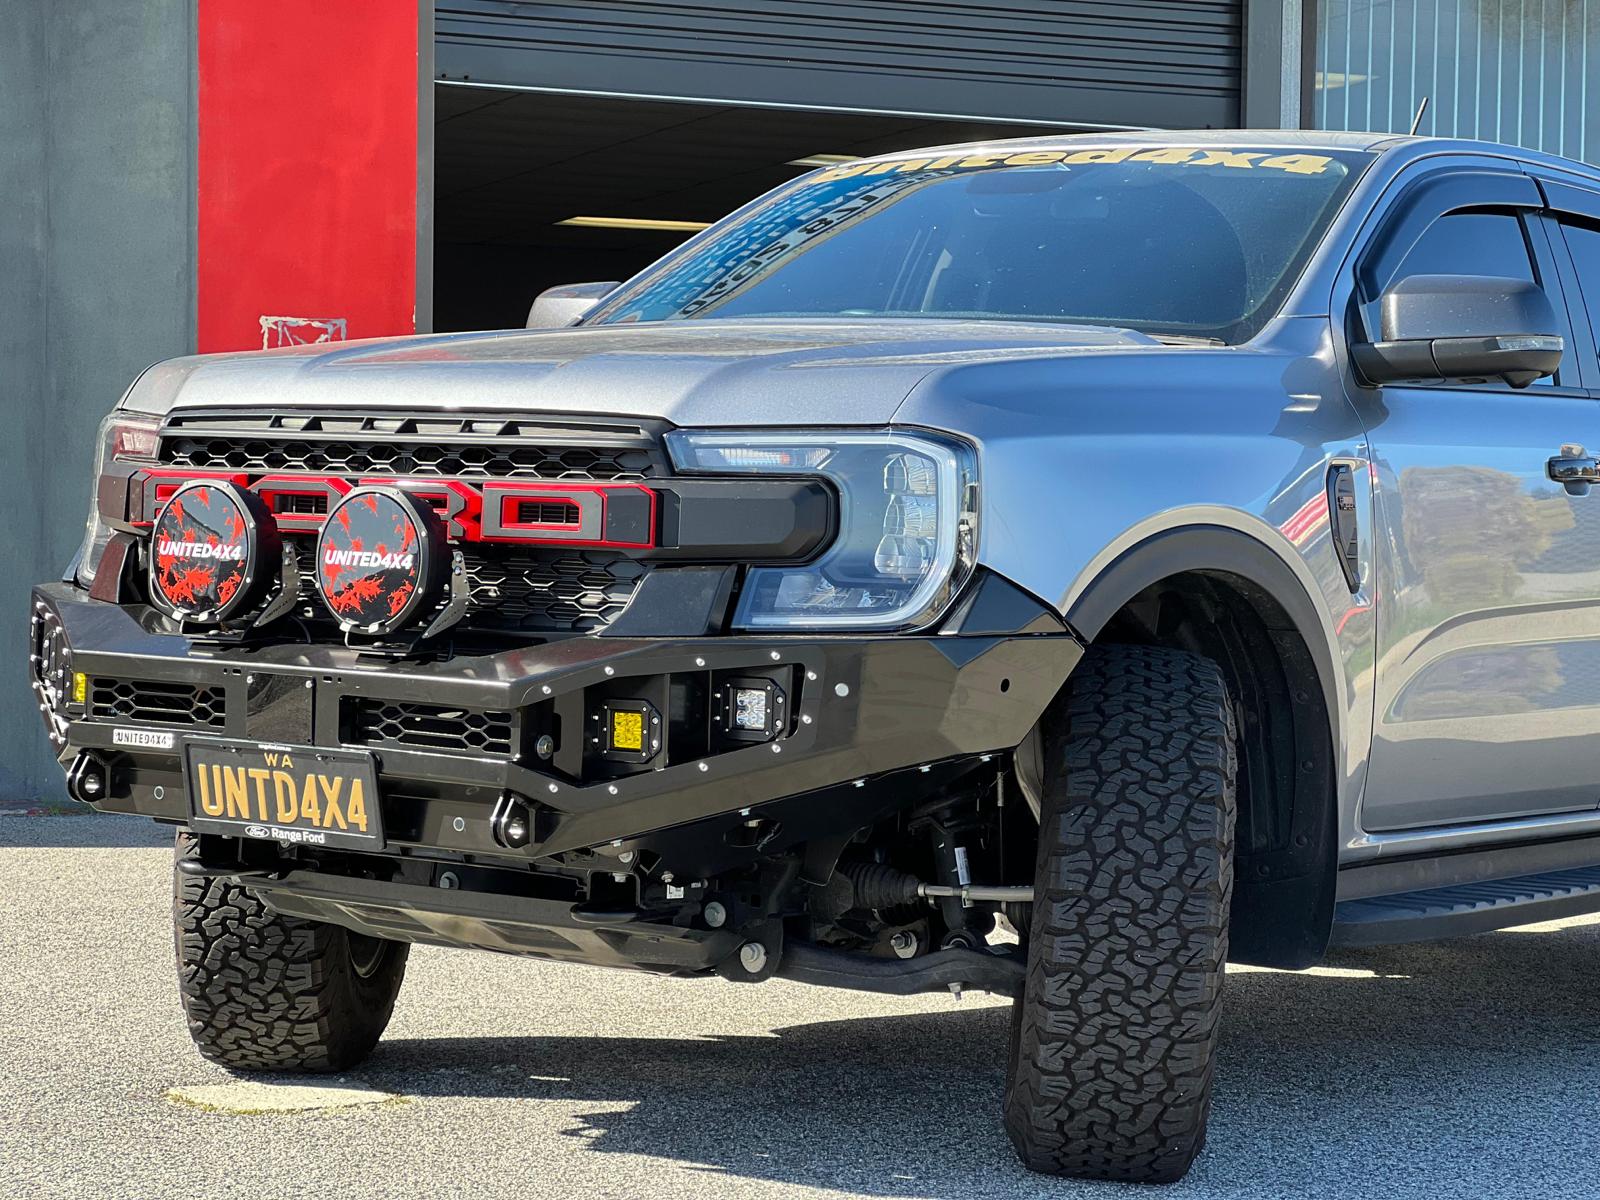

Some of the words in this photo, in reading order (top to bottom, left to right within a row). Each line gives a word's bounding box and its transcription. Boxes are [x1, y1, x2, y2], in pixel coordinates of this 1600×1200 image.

[810, 147, 1334, 183] united4x4
[159, 540, 242, 560] UNITED4X4
[324, 550, 414, 570] UNITED4X4
[116, 731, 167, 745] UNITED4X4
[264, 752, 294, 768] WA
[198, 763, 368, 832] UNTD4X4
[271, 828, 302, 842] Range
[302, 831, 325, 844] Ford
